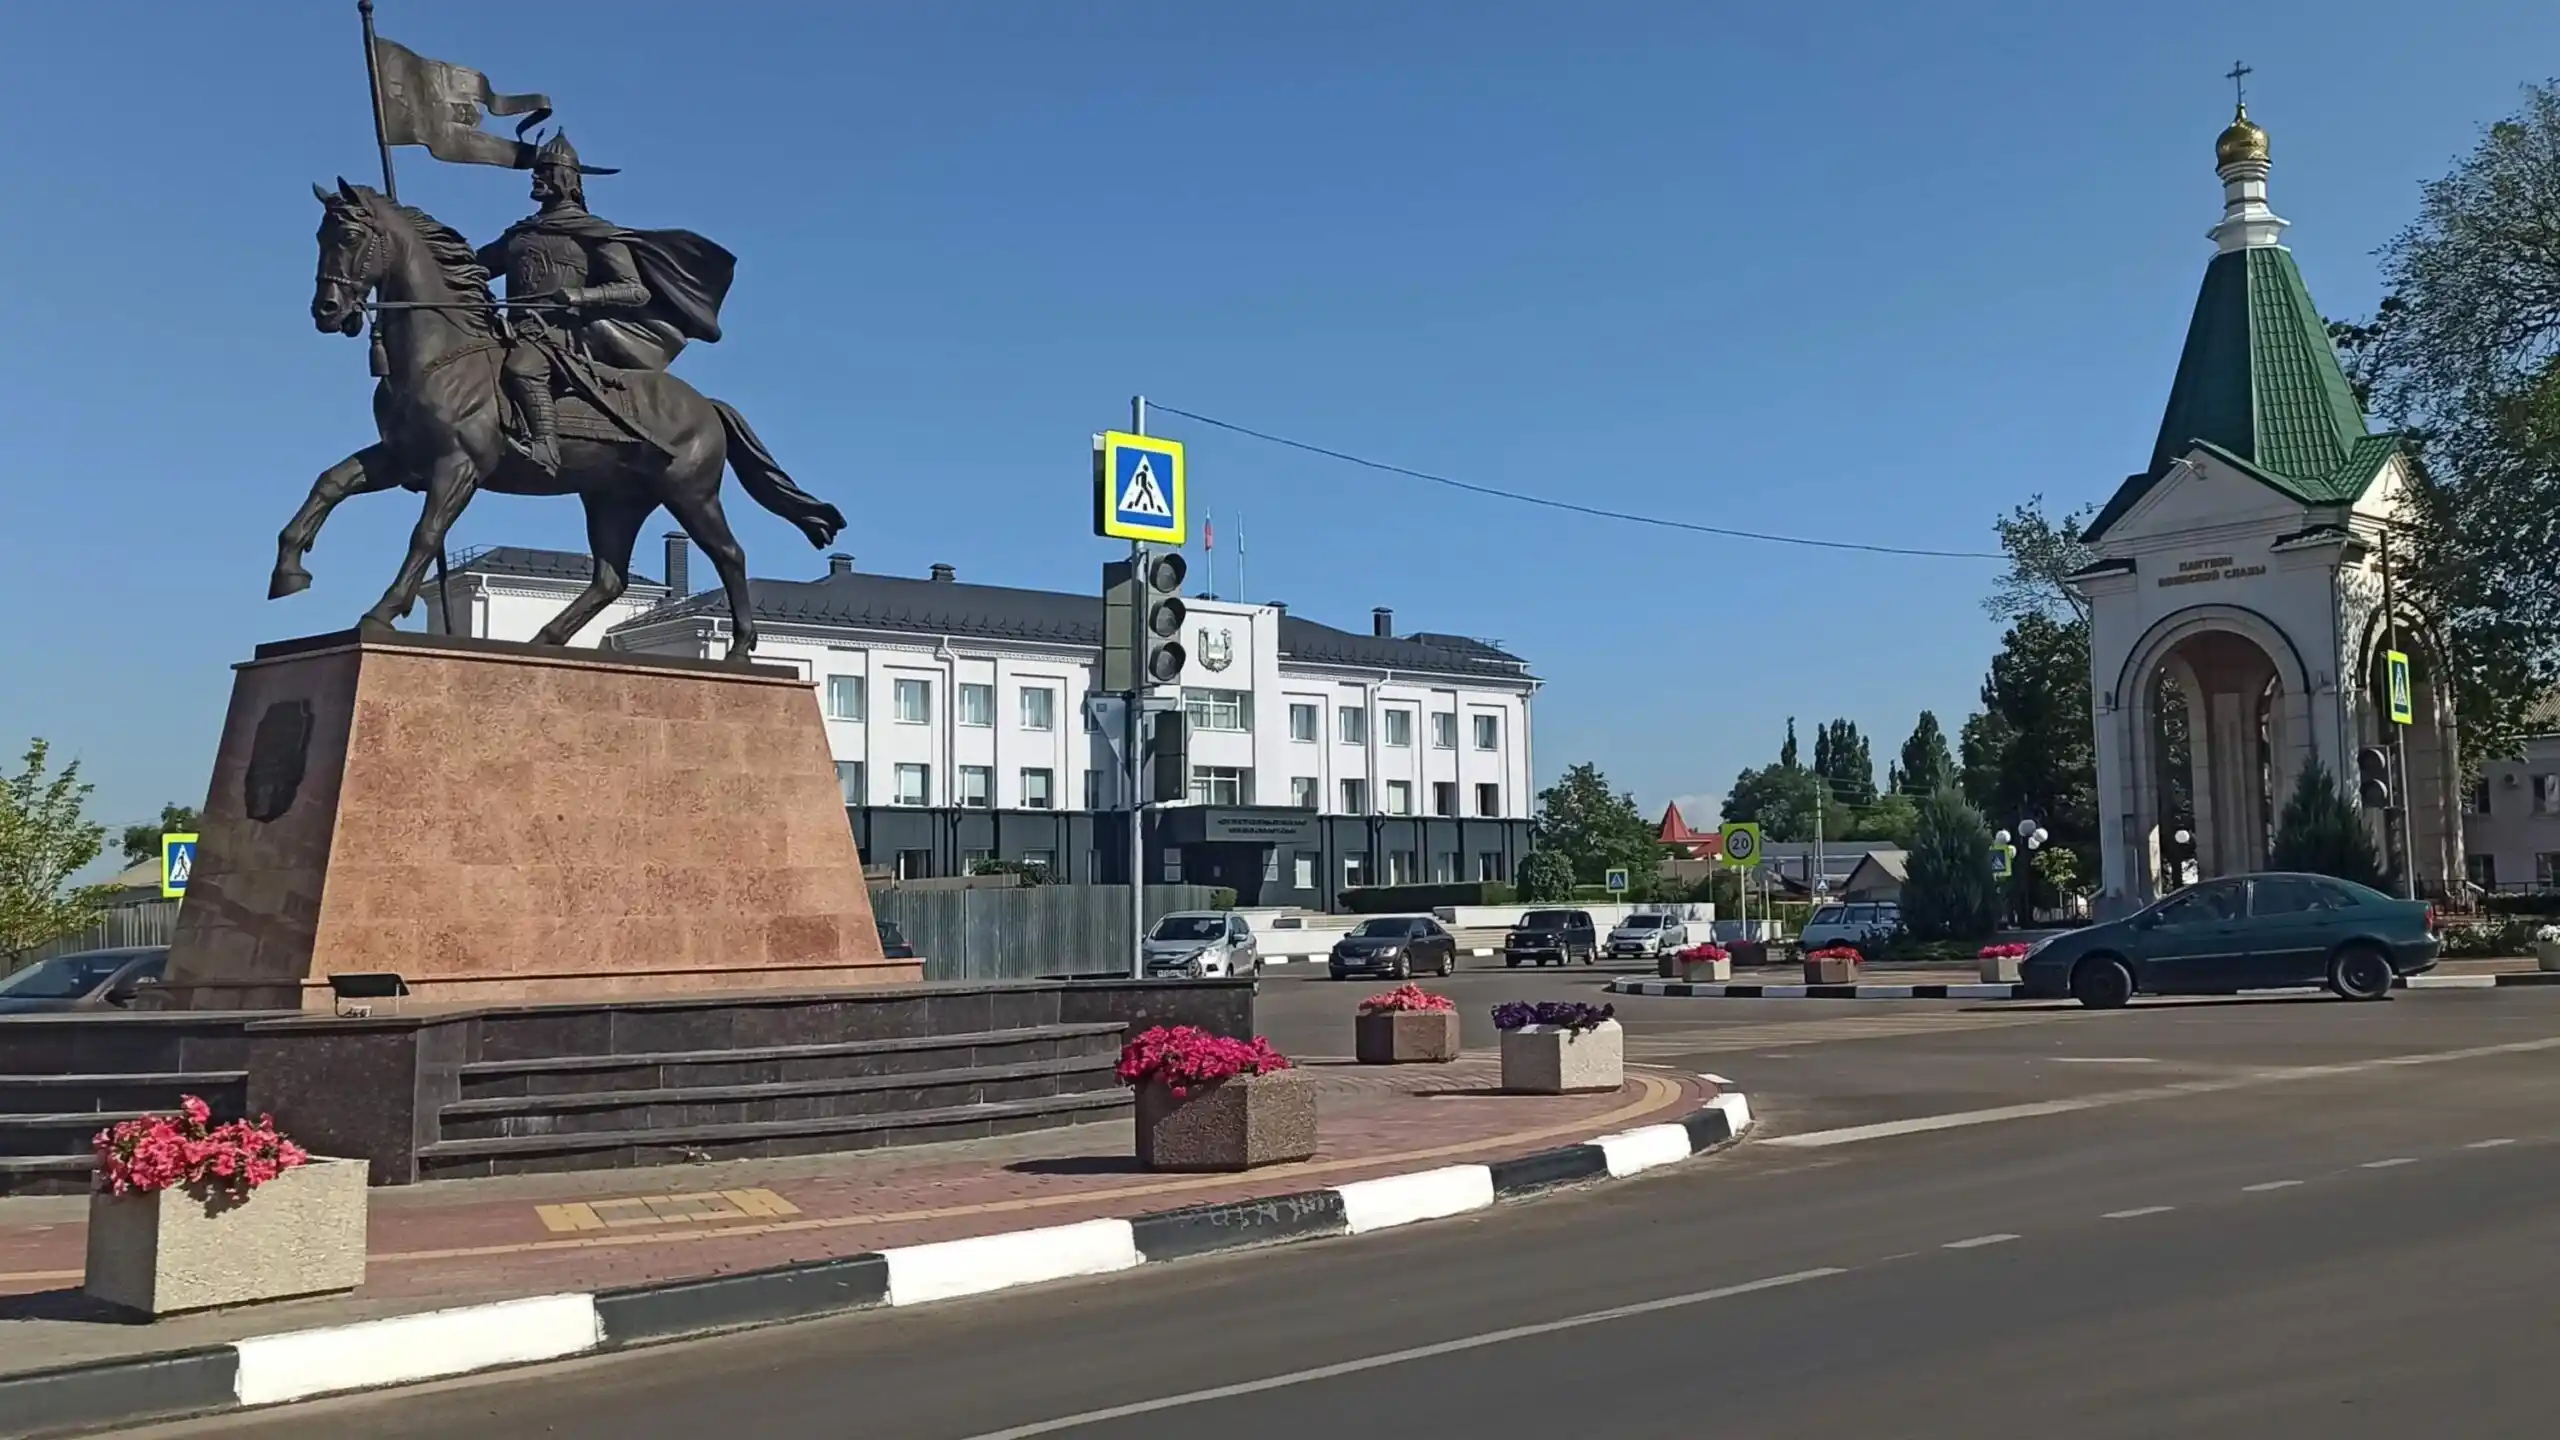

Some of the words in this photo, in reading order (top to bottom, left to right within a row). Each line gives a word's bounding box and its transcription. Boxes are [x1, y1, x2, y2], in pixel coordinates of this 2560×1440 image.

[2179, 556, 2233, 571] ПАНТЕОН
[2224, 565, 2266, 579] СЛАВЫ
[1731, 837, 1749, 851] 20
